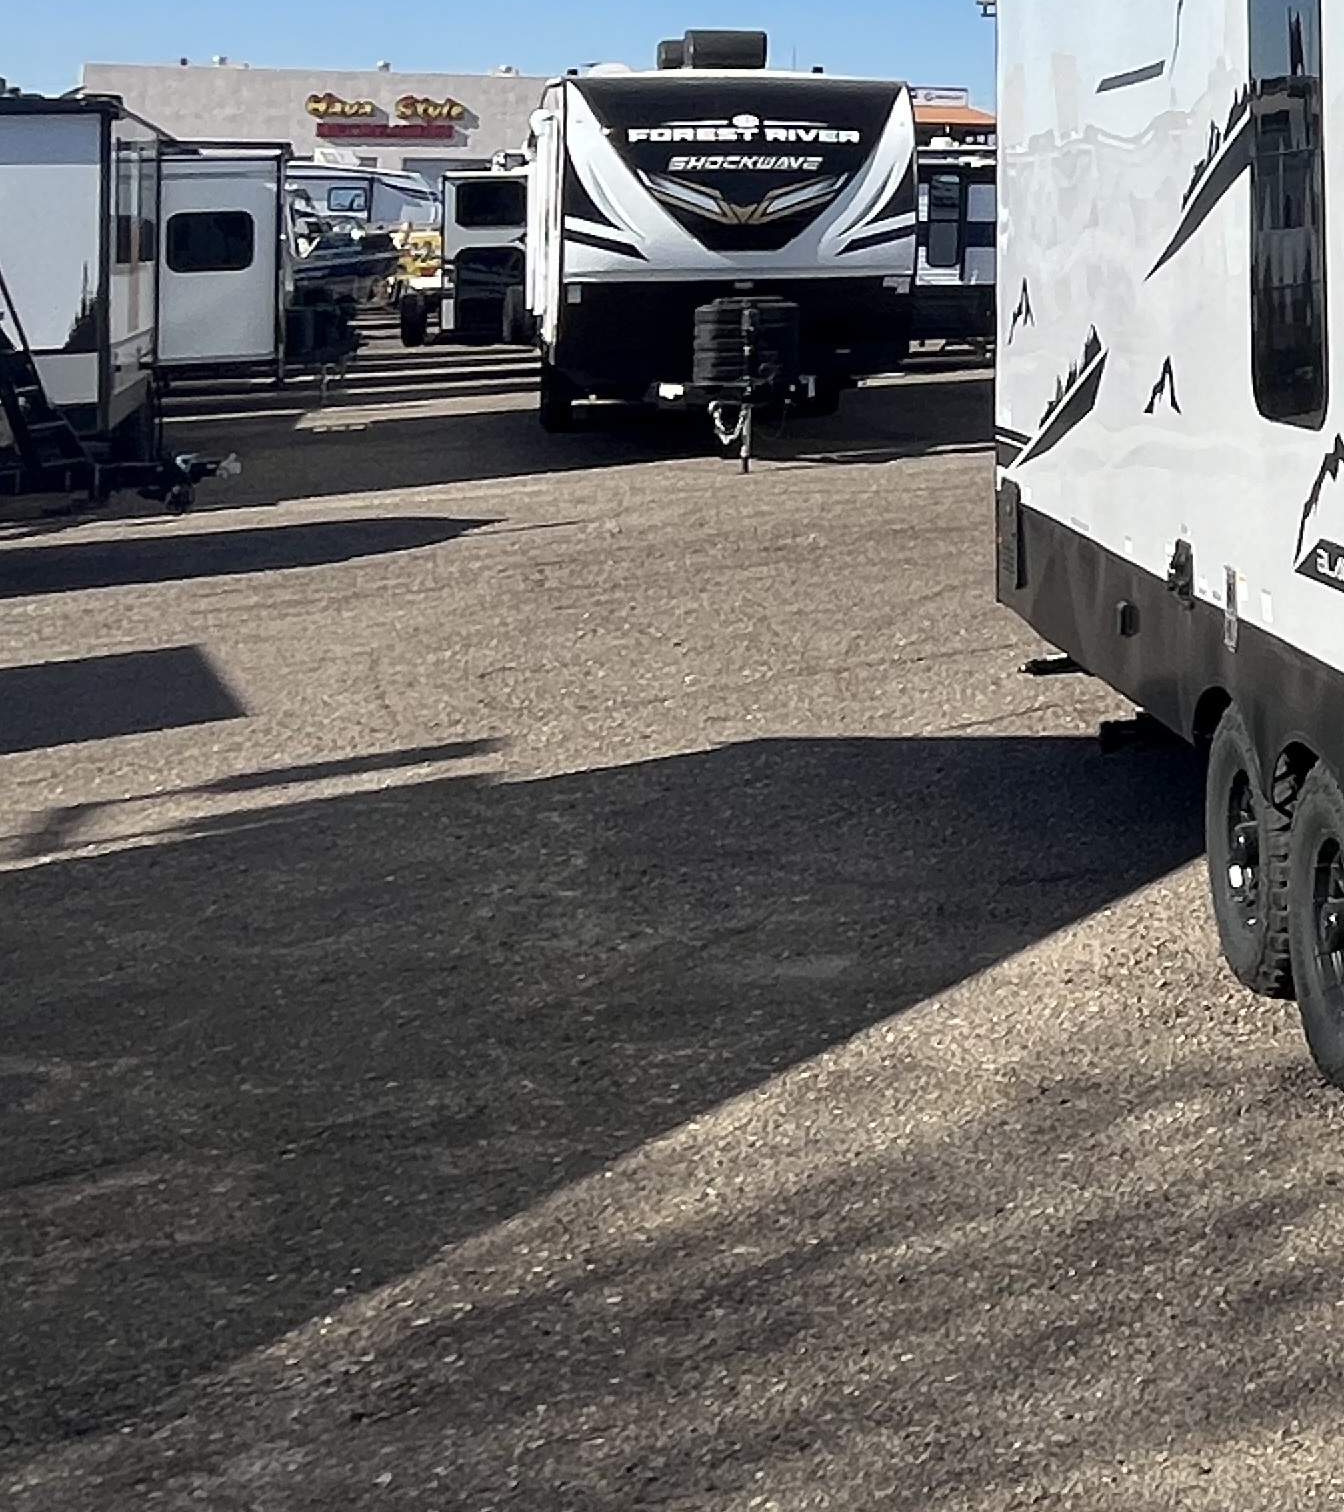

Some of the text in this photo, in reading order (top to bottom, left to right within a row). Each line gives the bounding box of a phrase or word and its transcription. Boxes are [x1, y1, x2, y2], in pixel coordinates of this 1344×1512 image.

[627, 128, 861, 144] FOREST RIVER
[667, 156, 824, 171] SHOCKWAVE
